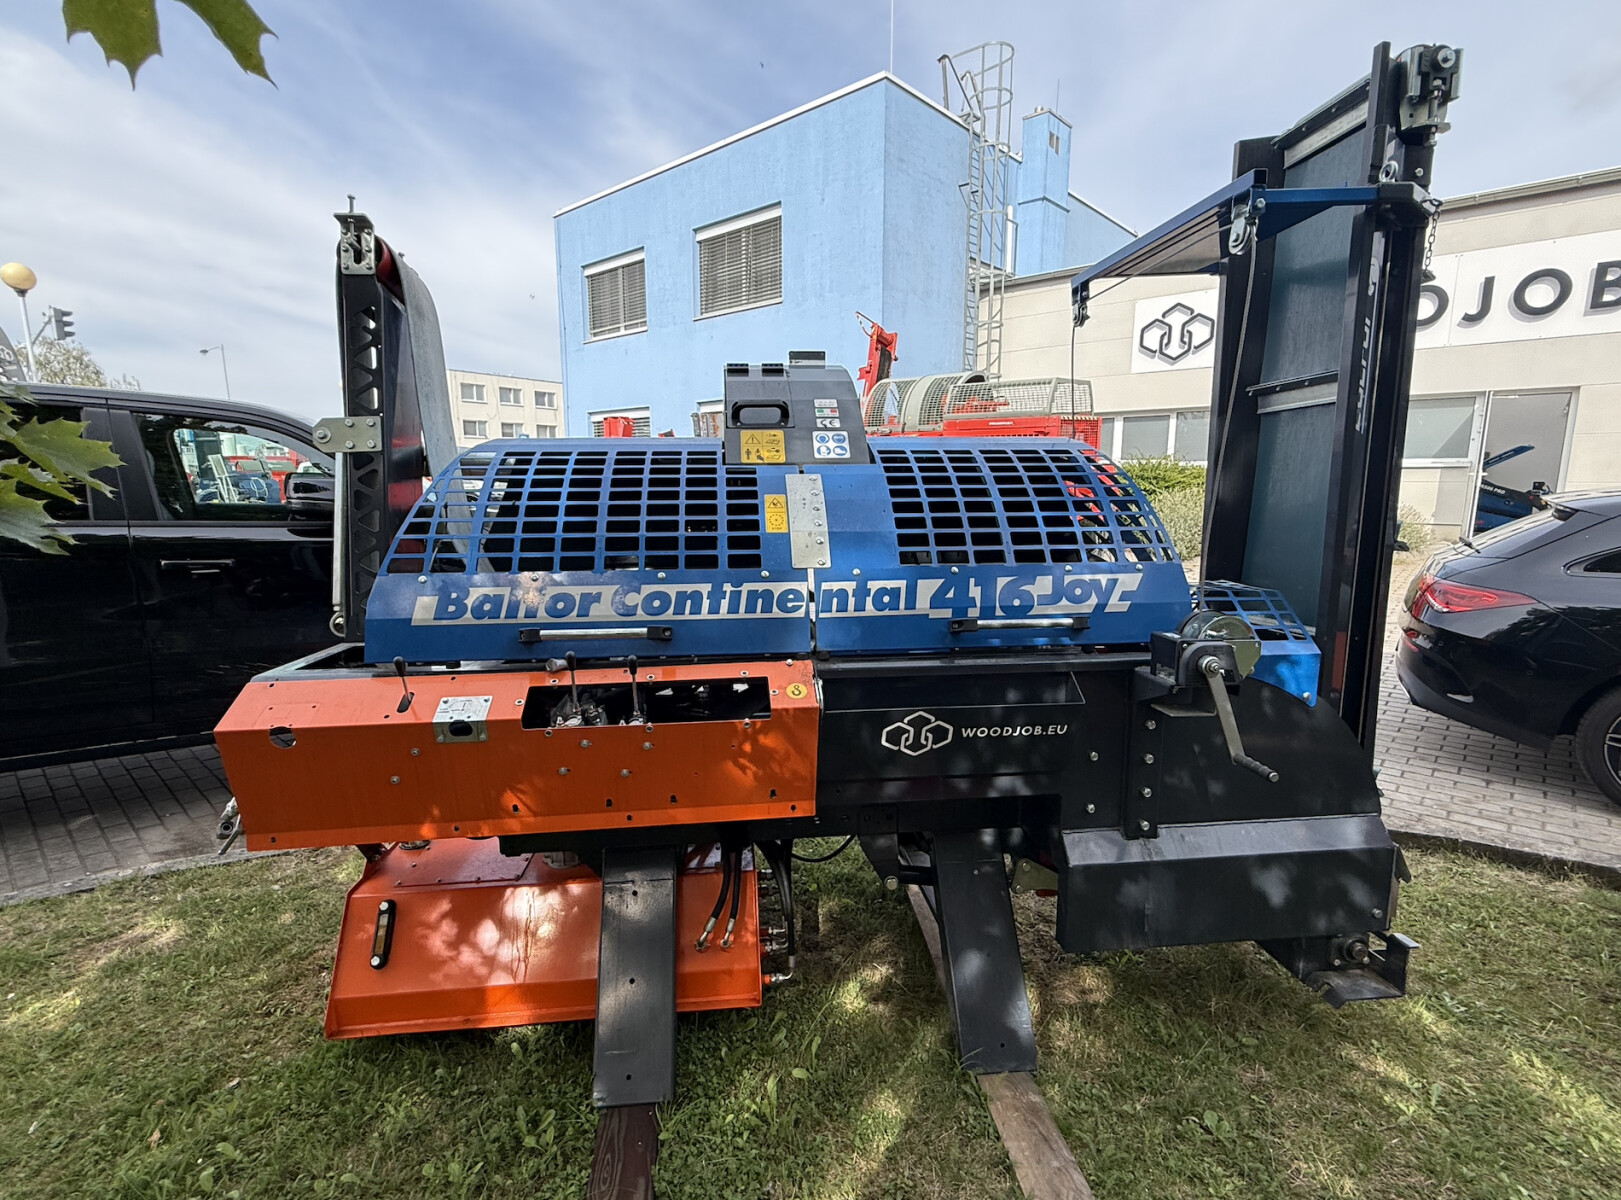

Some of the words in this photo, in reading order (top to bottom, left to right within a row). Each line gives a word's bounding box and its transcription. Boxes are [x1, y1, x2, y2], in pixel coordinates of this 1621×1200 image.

[433, 586, 602, 620] Balfor
[611, 579, 918, 617] Continental
[929, 576, 1037, 618] 416
[1037, 575, 1120, 613] Joy
[961, 724, 1068, 738] WOODJOB.EU
